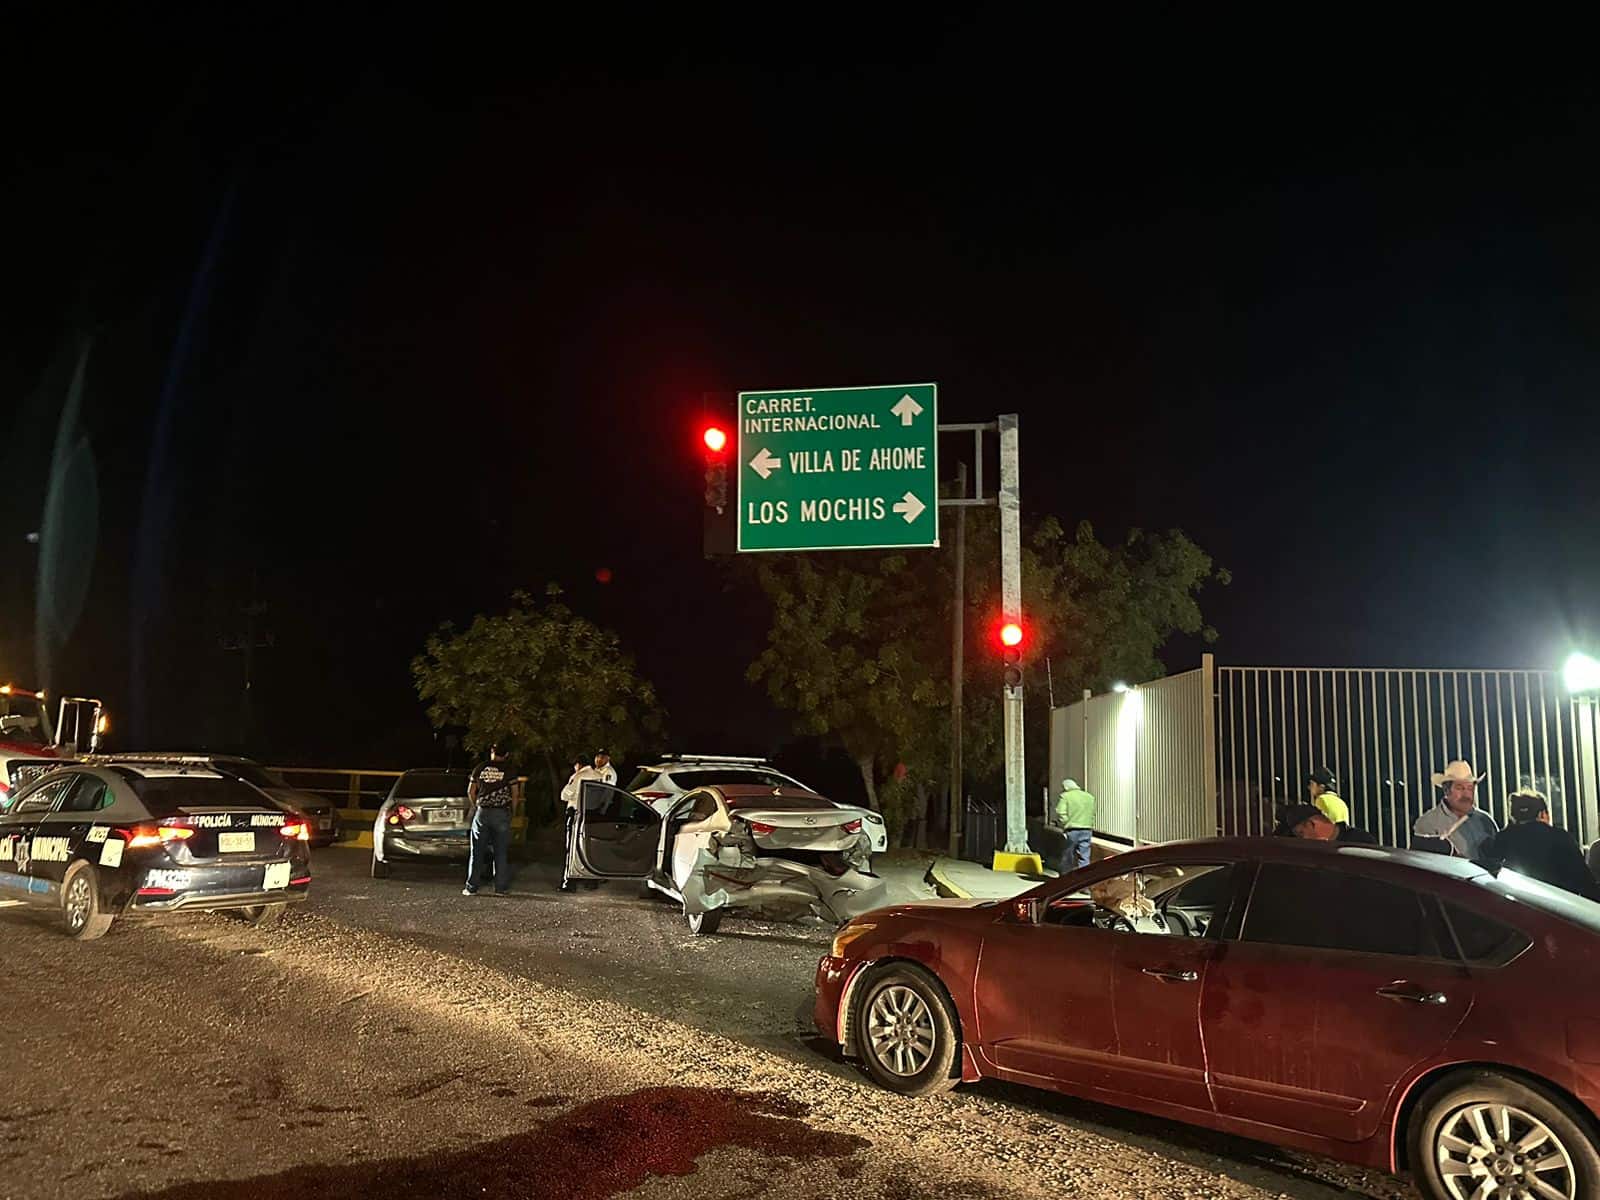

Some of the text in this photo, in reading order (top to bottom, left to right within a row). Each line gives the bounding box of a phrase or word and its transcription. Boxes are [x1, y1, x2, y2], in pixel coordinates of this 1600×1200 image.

[746, 397, 816, 414] CARRET.
[745, 414, 880, 434] INTERNACIONAL
[789, 447, 926, 474] VILLA DE AHOME
[748, 497, 885, 524] LOS MOCHIS
[198, 813, 232, 828] POLICÍA
[250, 815, 286, 827] MUNICIPAL
